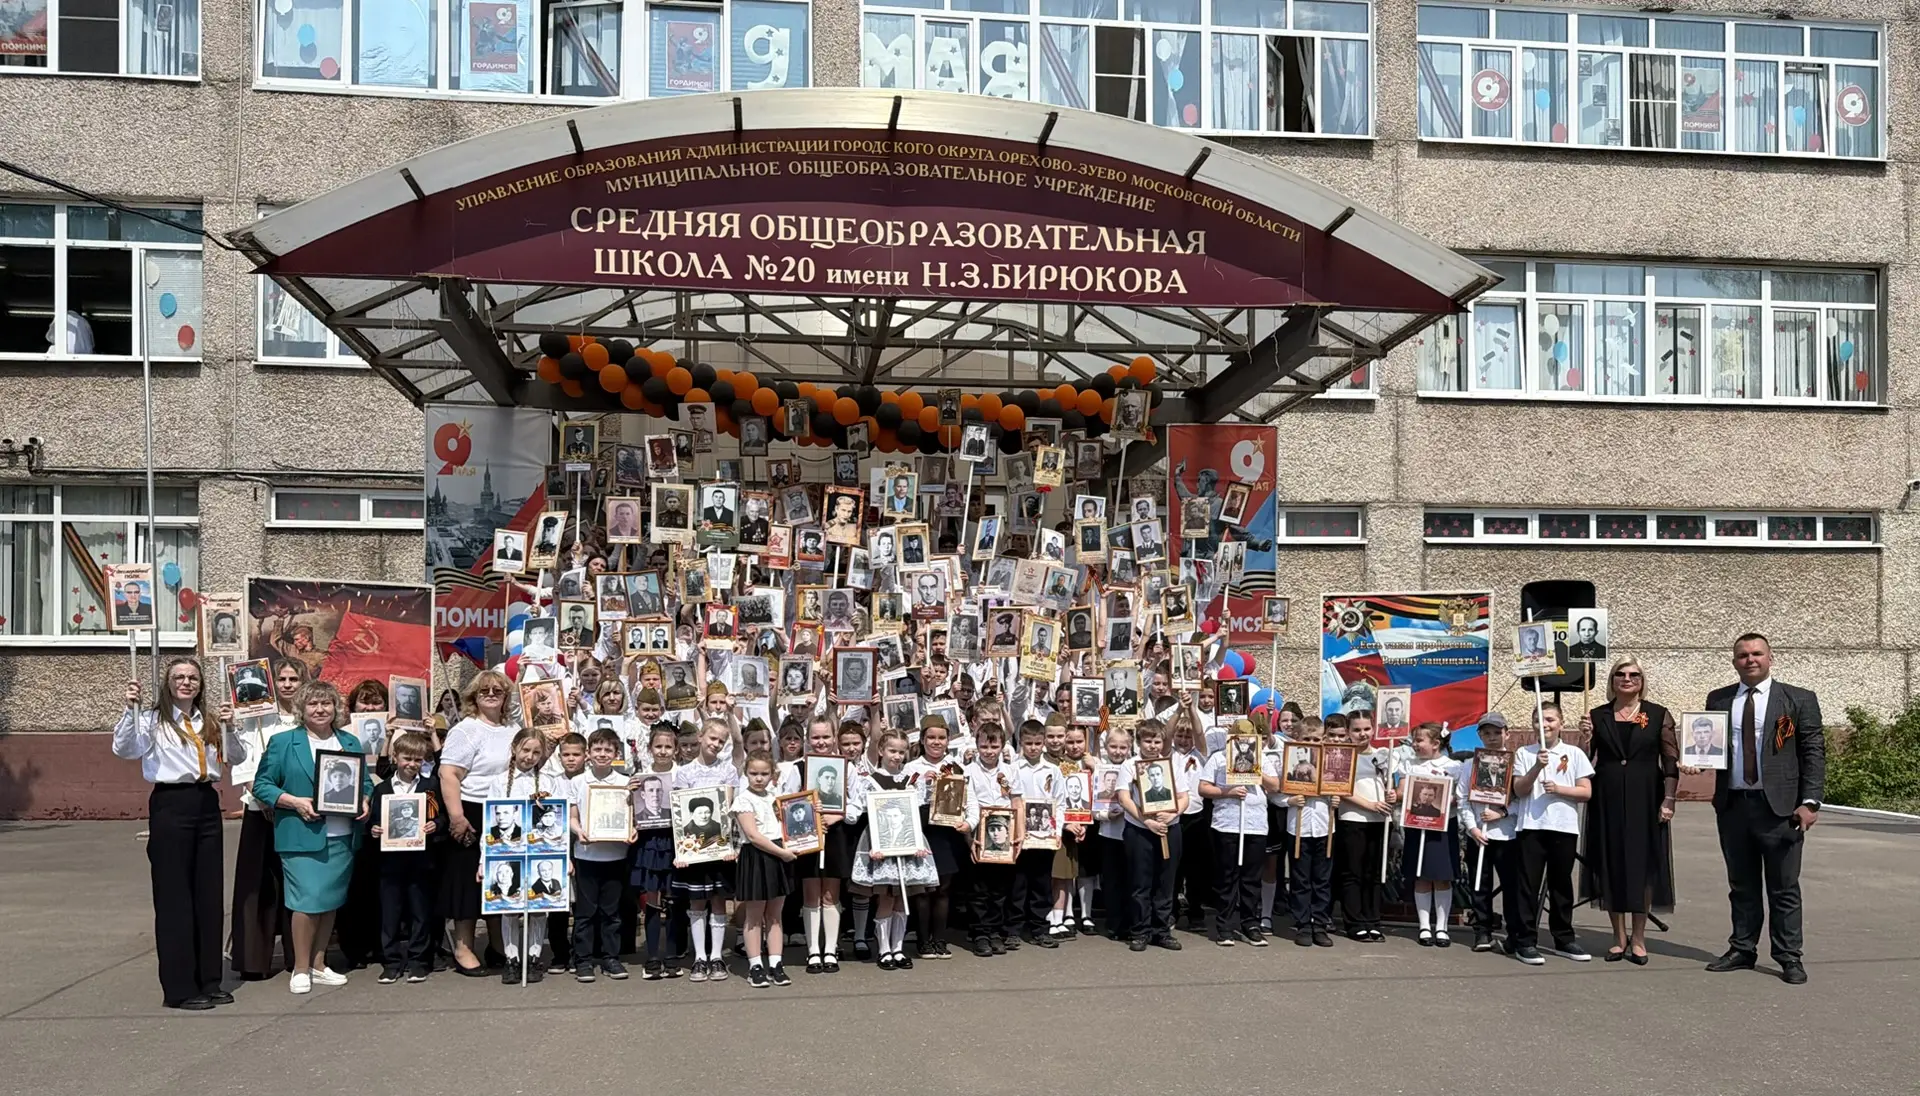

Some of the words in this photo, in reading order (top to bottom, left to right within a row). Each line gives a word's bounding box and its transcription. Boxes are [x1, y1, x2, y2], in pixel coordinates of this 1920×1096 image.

[1, 42, 46, 51] ПОМНИМ!
[472, 62, 515, 70] ГОРДИМСЯ!
[864, 32, 1029, 100] МАЯ
[669, 79, 711, 88] ГОРДИМСЯ!
[455, 170, 561, 212] УПРАВЛЕНИЕ
[564, 148, 682, 180] ОБРАЗОВАНИЯ
[685, 139, 830, 161] АДМИНИСТРАЦИИ
[833, 139, 934, 157] ГОРОДСКОГО
[937, 143, 996, 162] ОКРУГА
[999, 148, 1127, 183] ОРЕХОВО-ЗУЕВО
[1131, 174, 1235, 216] МОСКОВСКОЙ
[1235, 206, 1301, 244] ОБЛАСТИ
[605, 160, 781, 195] МУНИЦИПАЛЬНОЕ
[788, 159, 1028, 188] ОБЩЕОБРАЗОВАТЕЛЬНОЕ
[1033, 174, 1156, 214] УЧРЕЖДЕНИЕ
[570, 206, 741, 241] СРЕДНЯЯ
[749, 212, 1207, 256] ОБЩЕОБРАЗОВАТЕЛЬНАЯ
[593, 248, 733, 281] ШКОЛА
[743, 254, 815, 284] №20
[826, 267, 909, 287] имени
[922, 262, 1188, 295] Н.З.БИРЮКОВА
[433, 423, 472, 476] 9
[1382, 656, 1419, 667] Родину
[1385, 641, 1414, 650] такая
[1416, 640, 1473, 652] профессия
